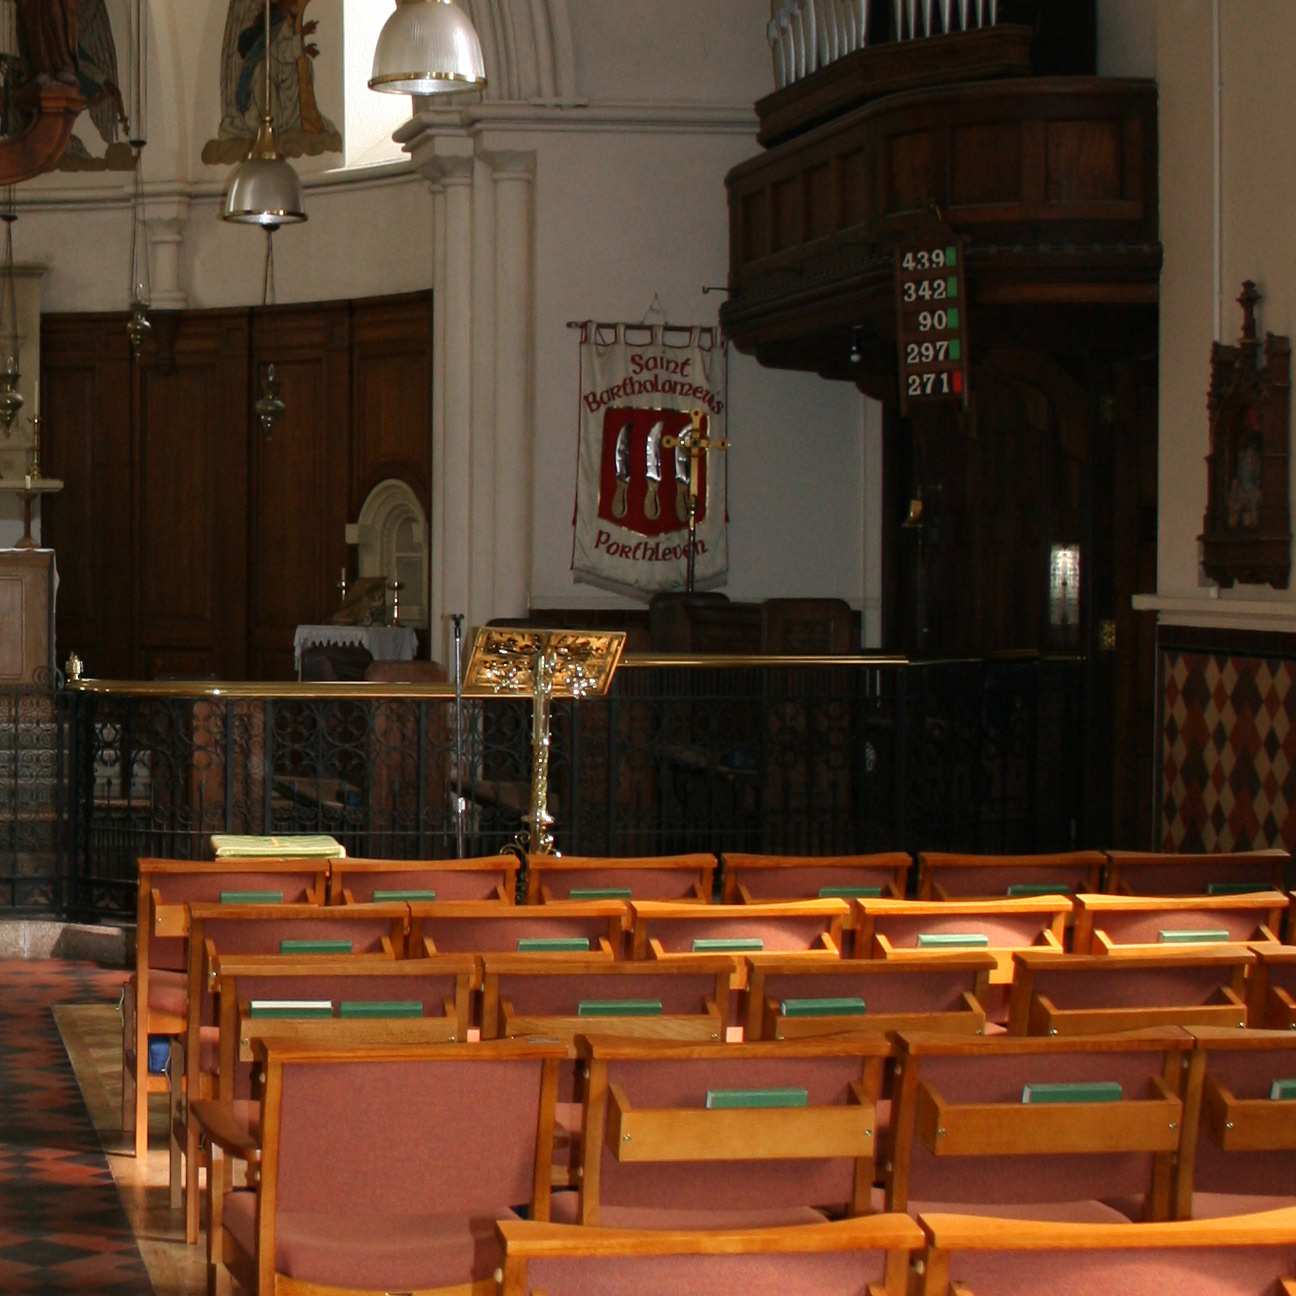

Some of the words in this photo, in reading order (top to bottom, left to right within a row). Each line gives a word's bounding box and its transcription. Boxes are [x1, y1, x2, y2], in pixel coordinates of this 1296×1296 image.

[902, 249, 945, 271] 439
[903, 279, 946, 302] 342
[918, 310, 947, 332] 90
[907, 341, 949, 364] 297
[630, 354, 692, 377] Saint
[908, 372, 949, 396] 271
